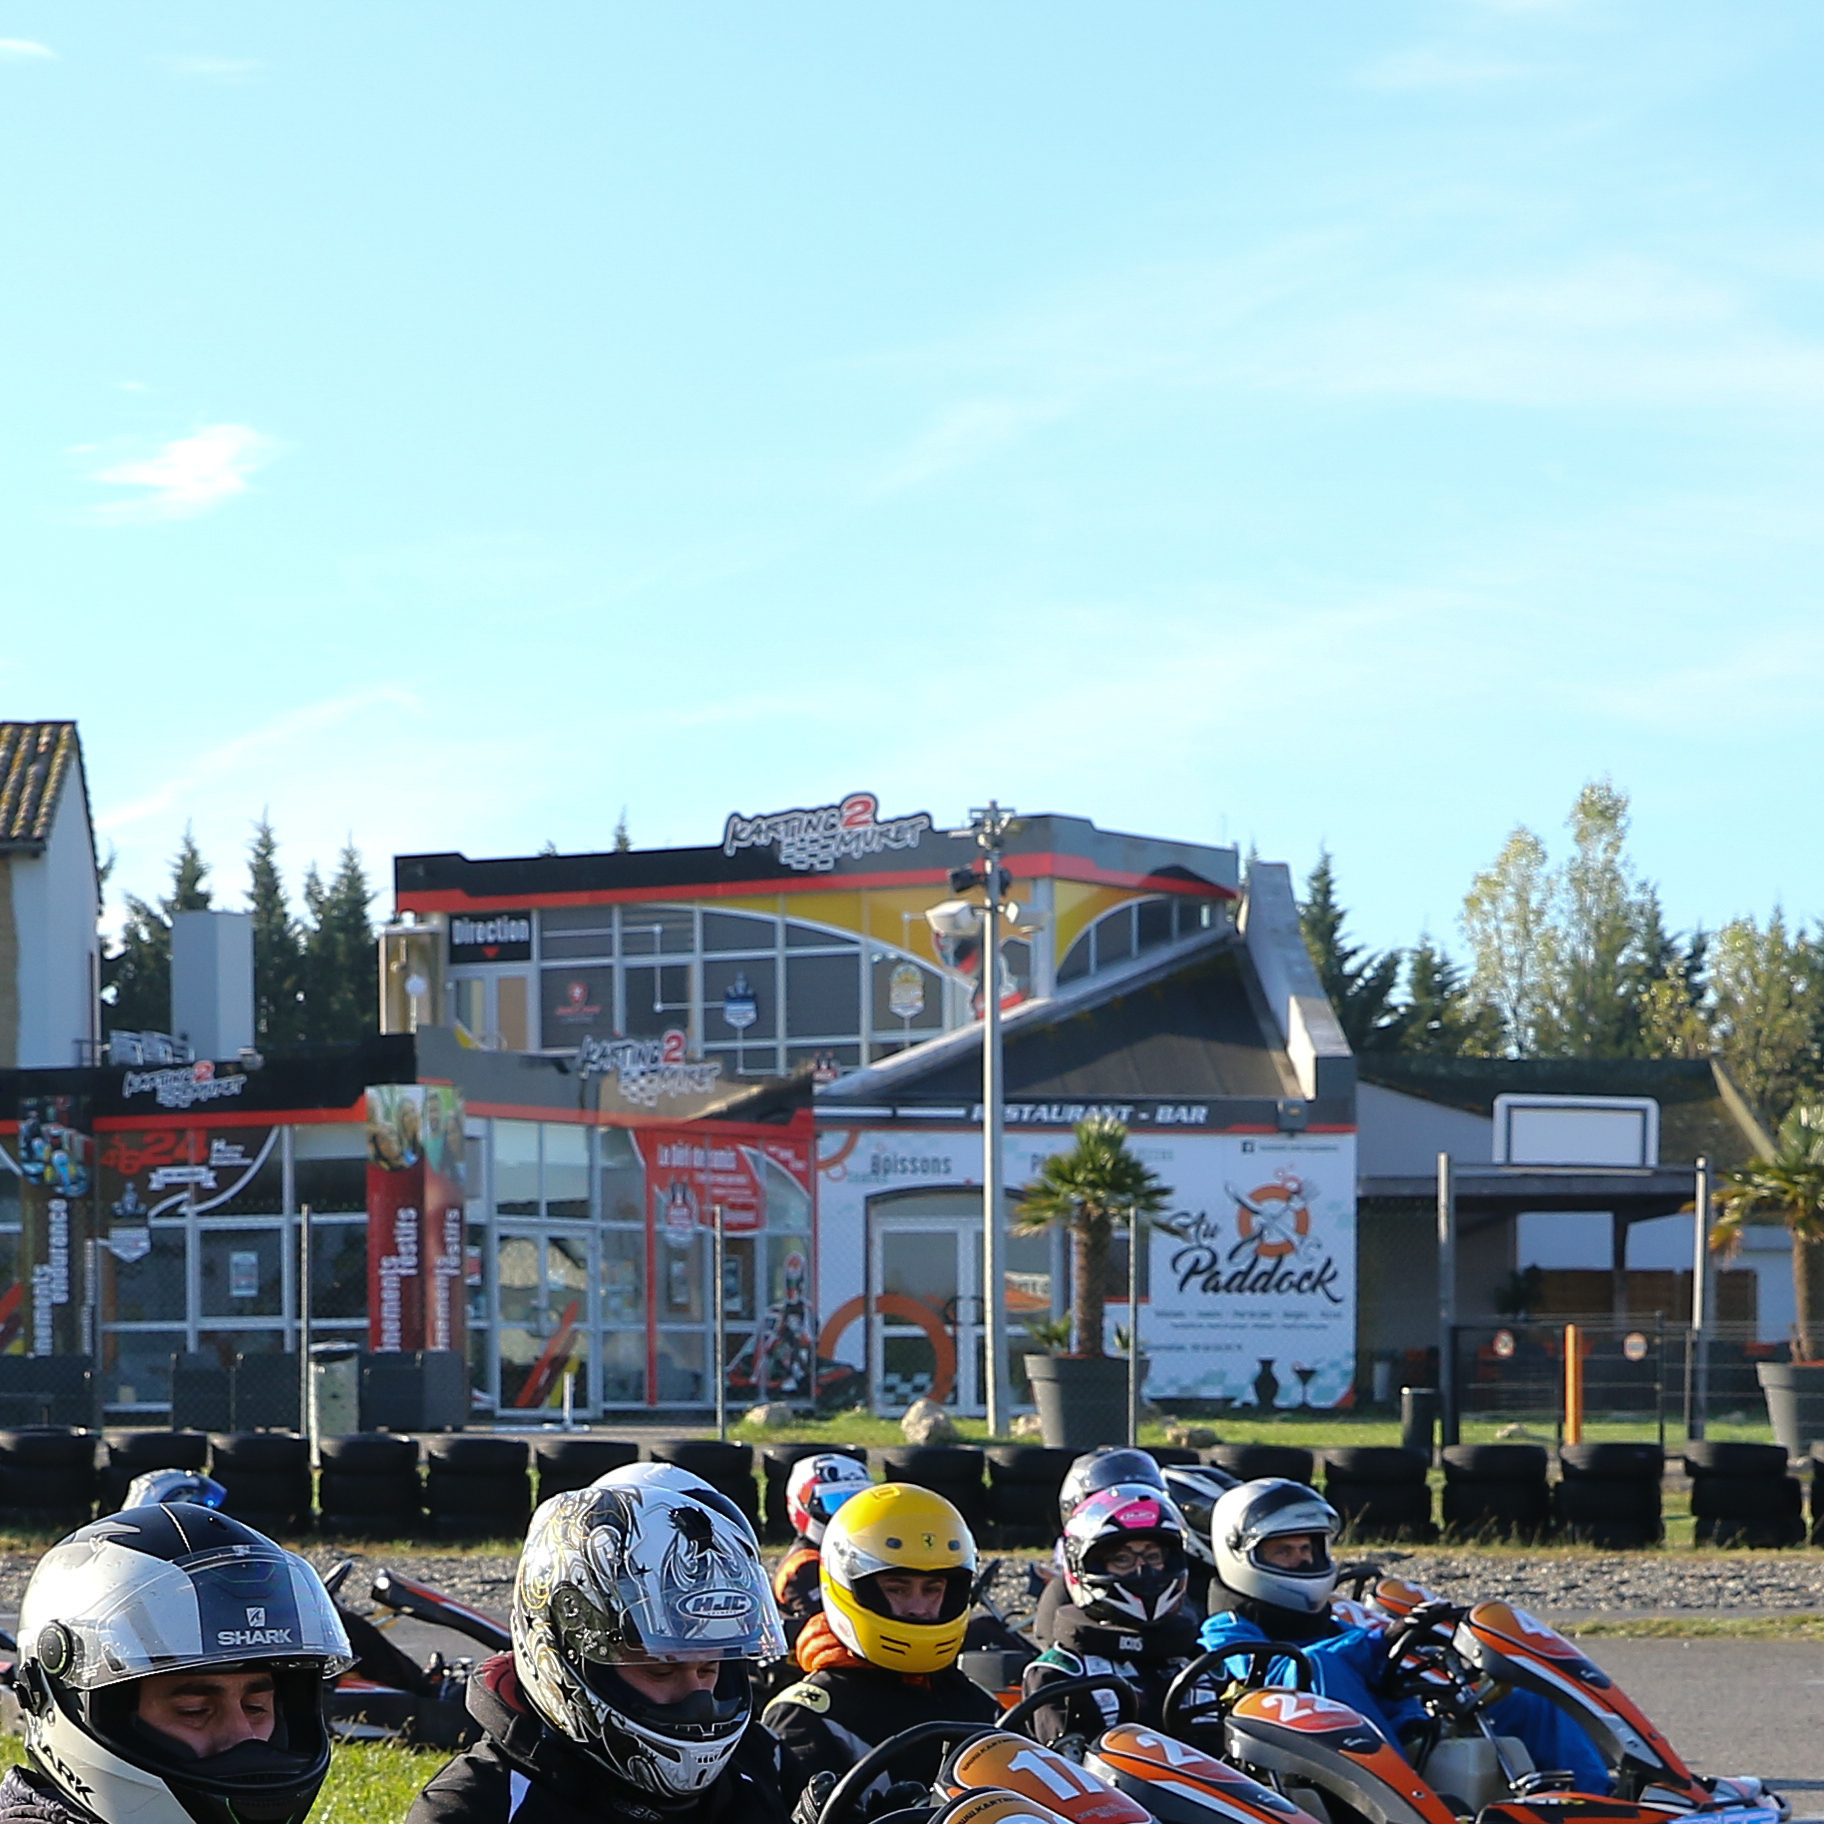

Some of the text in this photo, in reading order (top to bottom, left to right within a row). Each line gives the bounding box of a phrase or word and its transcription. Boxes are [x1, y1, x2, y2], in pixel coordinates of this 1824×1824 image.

[724, 798, 874, 857] KARTING 2
[836, 813, 930, 860] MURET
[451, 914, 531, 945] Direction
[192, 1060, 216, 1085] 2
[577, 1030, 686, 1079] KARTING 2
[972, 1103, 1133, 1123] RSTAURANT
[1155, 1105, 1208, 1123] BAR
[1168, 1209, 1218, 1247] Au
[1171, 1226, 1343, 1303] Paddock
[692, 1595, 747, 1613] HJC
[217, 1628, 293, 1646] SHARK
[1007, 1749, 1105, 1801] 17
